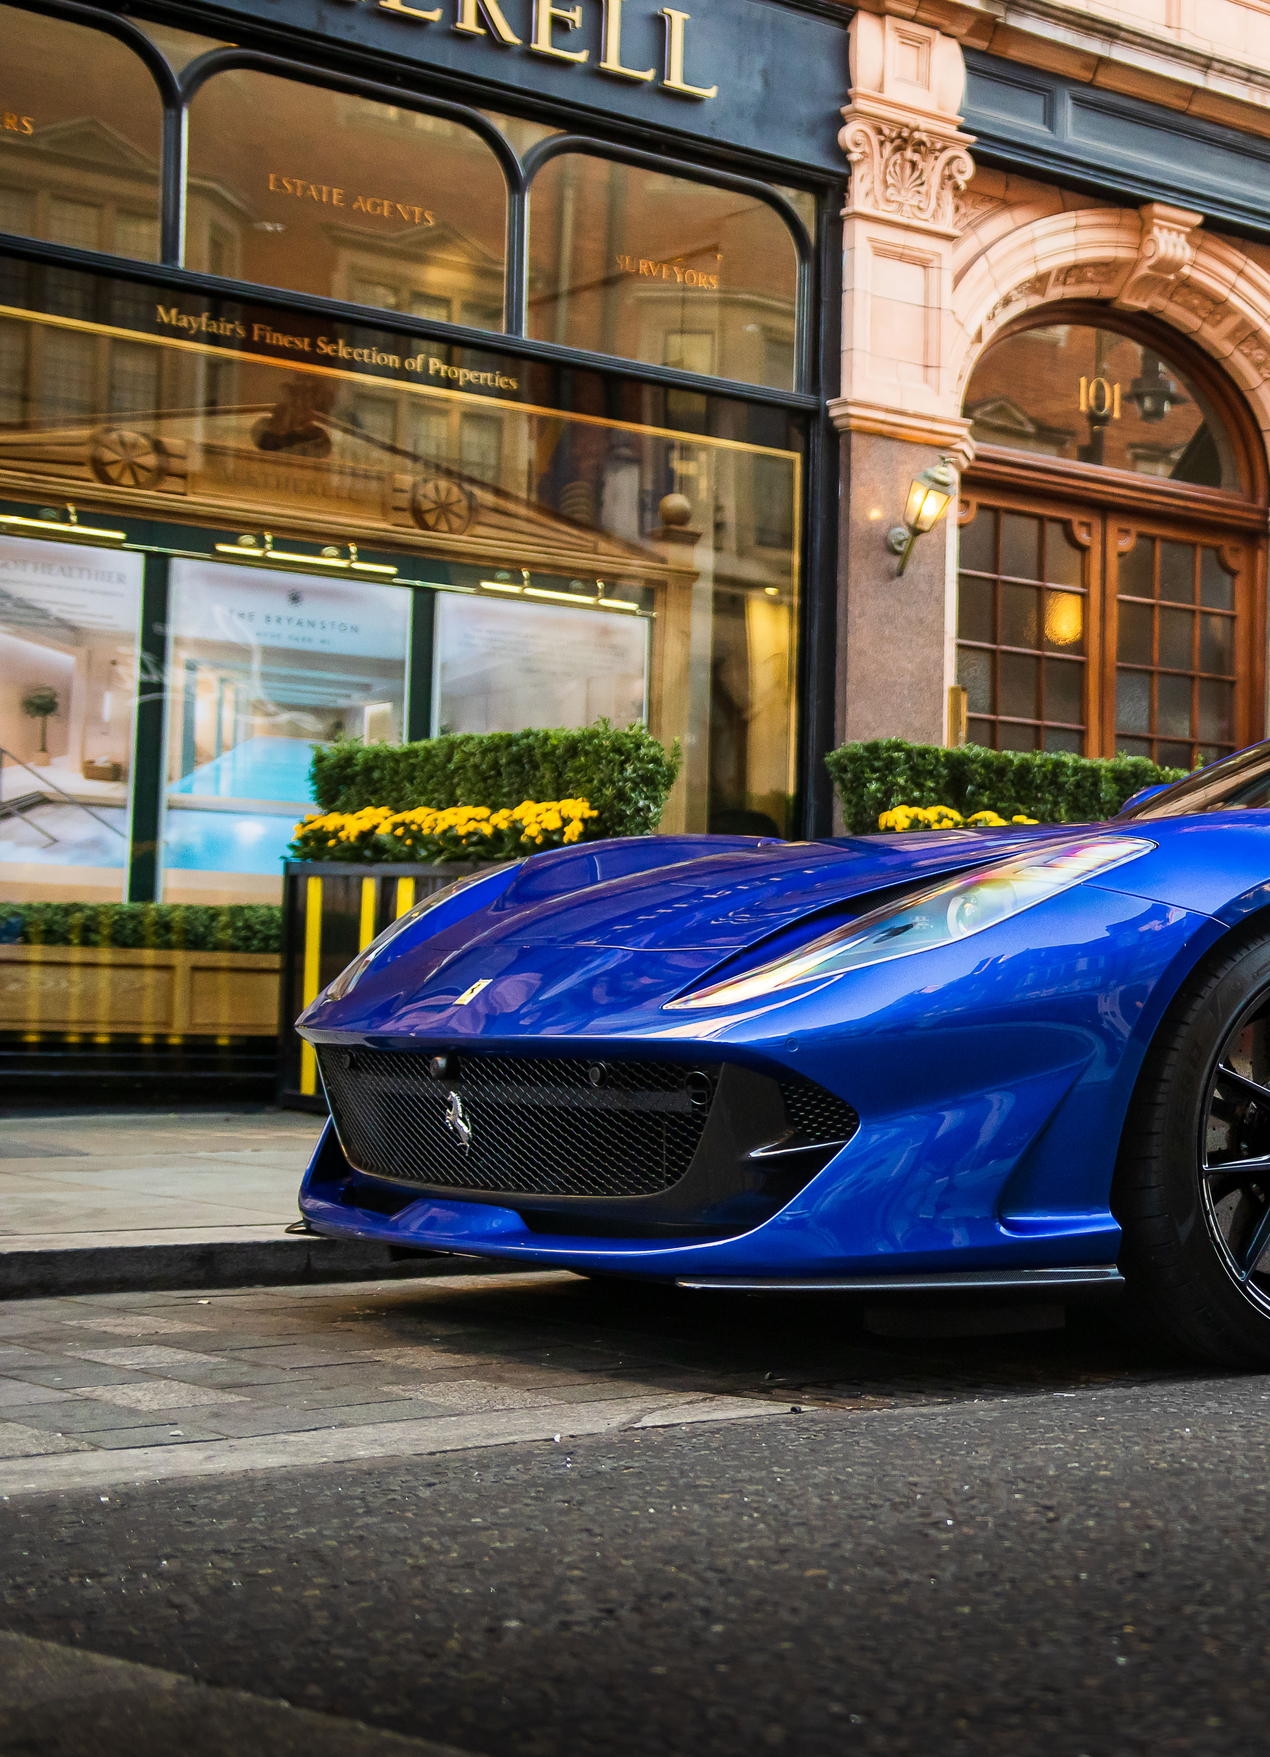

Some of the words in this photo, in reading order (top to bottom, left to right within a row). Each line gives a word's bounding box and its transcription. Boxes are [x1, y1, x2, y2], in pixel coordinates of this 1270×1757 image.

[0, 111, 35, 136] RS
[268, 173, 345, 208] ESTATE
[352, 195, 436, 227] AGENTS
[616, 254, 720, 290] SURVEYORS
[155, 304, 246, 338] Mayfair's
[252, 323, 313, 352] Finest
[316, 336, 401, 369] Selection
[404, 353, 425, 374] of
[428, 358, 520, 391] Properties
[1079, 375, 1121, 419] 101
[265, 613, 360, 635] BRYANSTON
